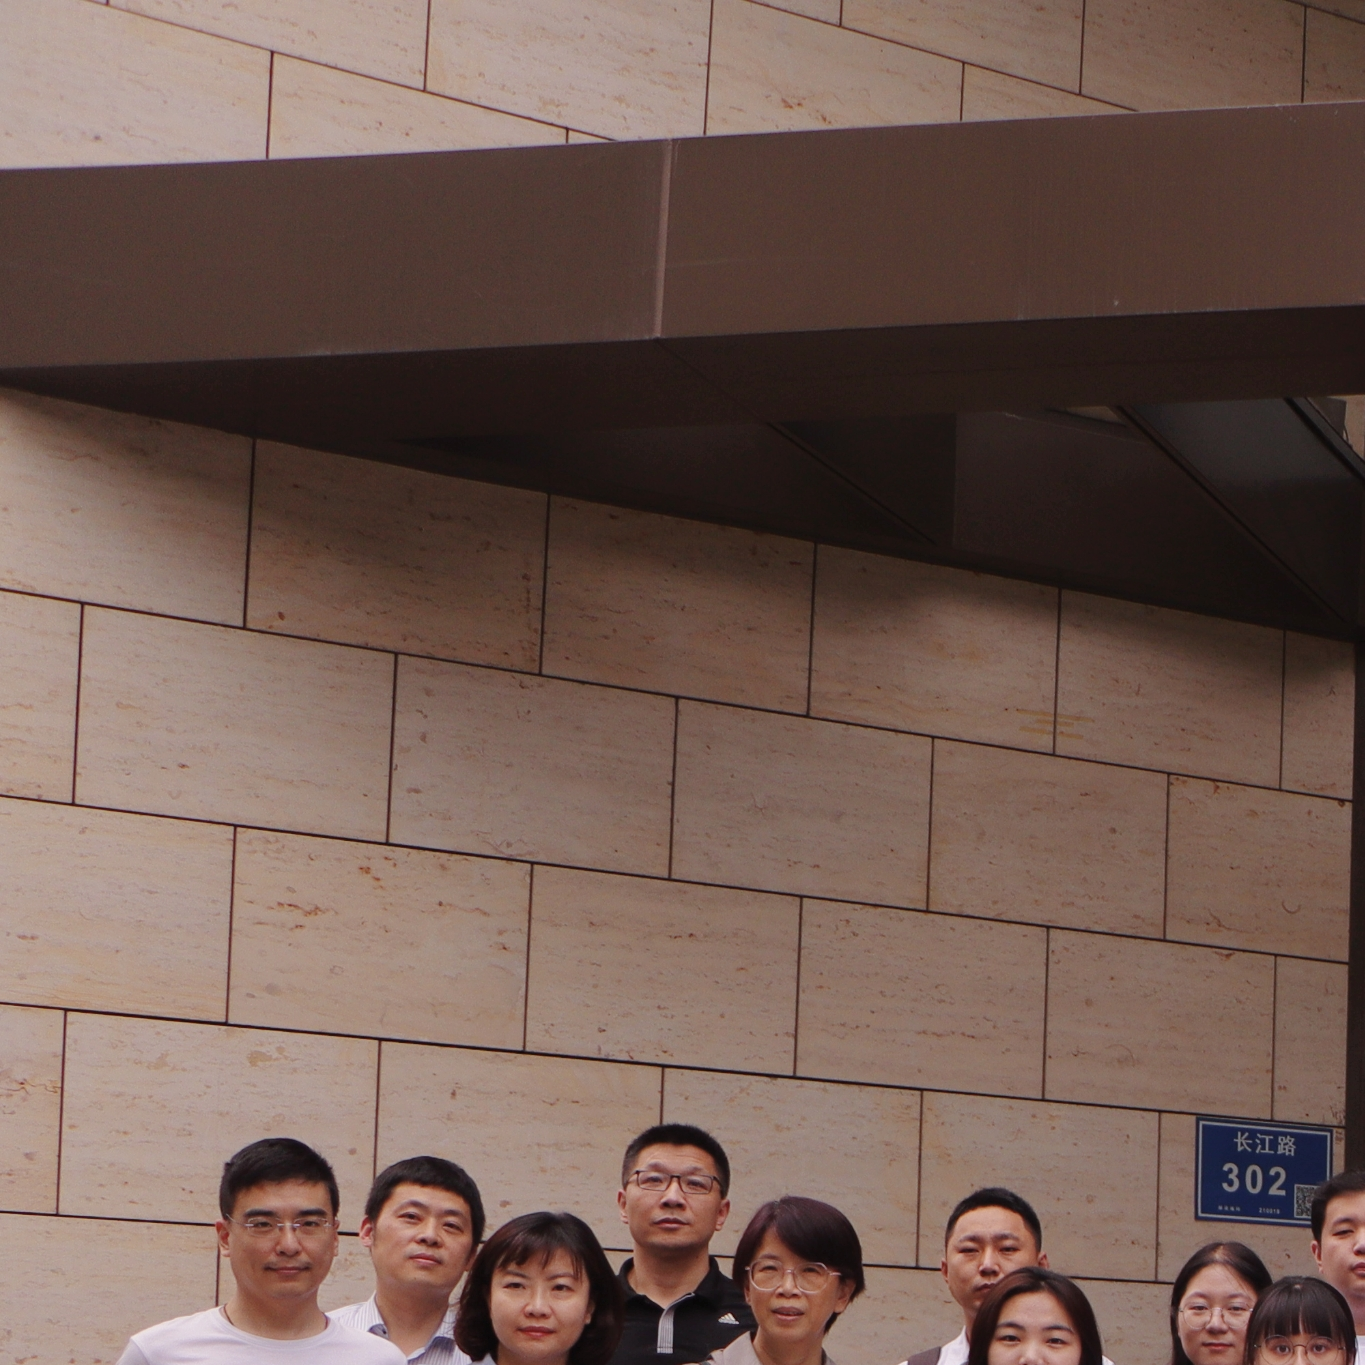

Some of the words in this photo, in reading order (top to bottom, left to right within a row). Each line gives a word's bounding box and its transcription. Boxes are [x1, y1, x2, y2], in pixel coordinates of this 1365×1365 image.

[1233, 1130, 1297, 1157] 长江路
[1221, 1162, 1287, 1196] 302
